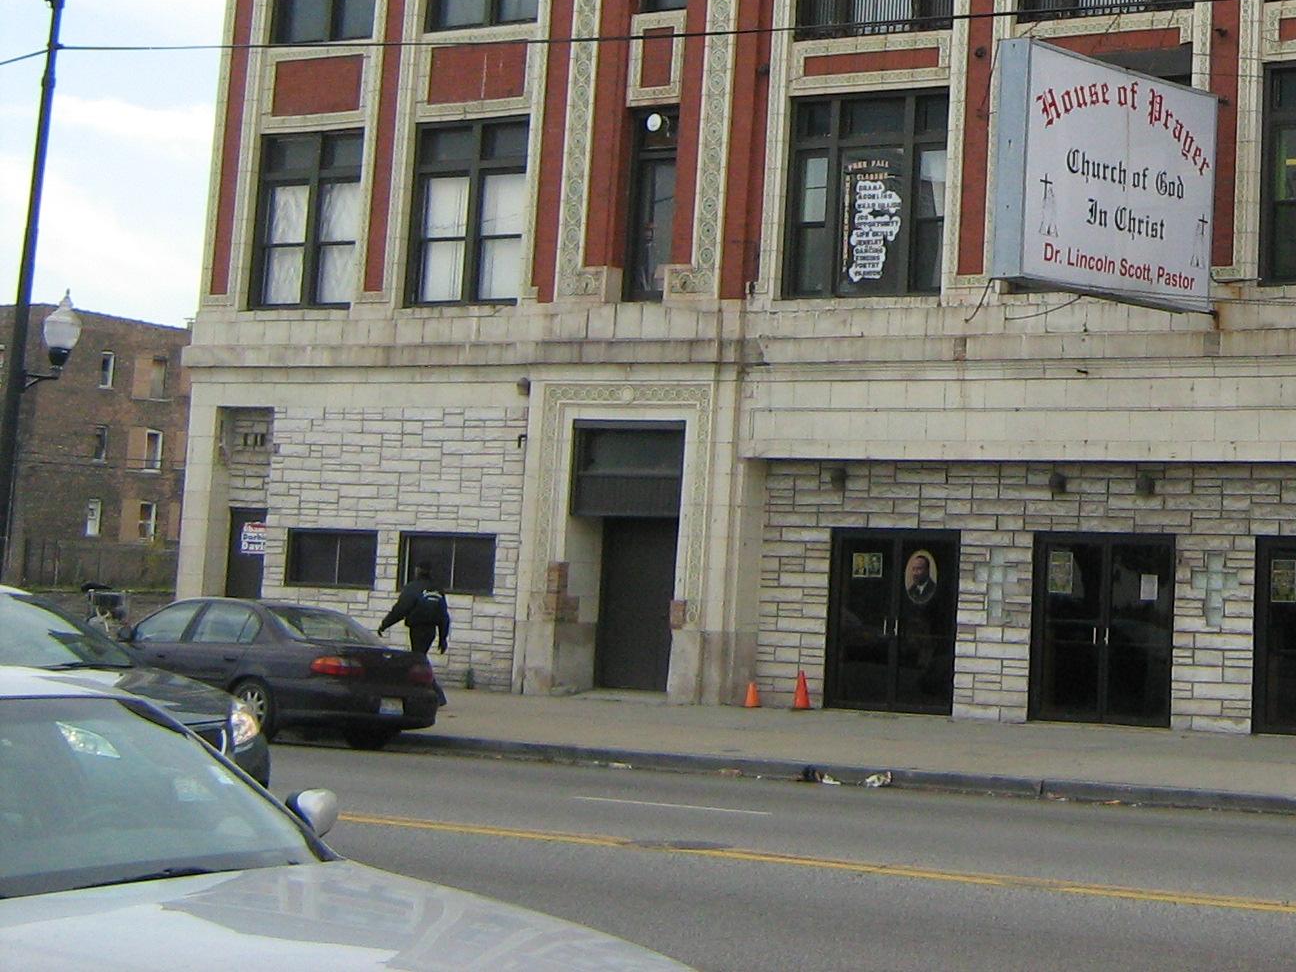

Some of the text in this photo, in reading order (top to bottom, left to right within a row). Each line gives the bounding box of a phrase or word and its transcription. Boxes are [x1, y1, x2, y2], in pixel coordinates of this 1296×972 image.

[1036, 81, 1210, 176] House of Prayer
[1066, 148, 1184, 200] Church of God
[1086, 198, 1165, 241] In Christ
[1043, 242, 1195, 291] Dr. Lincoln Scott, Pastor
[242, 541, 266, 550] Davi
